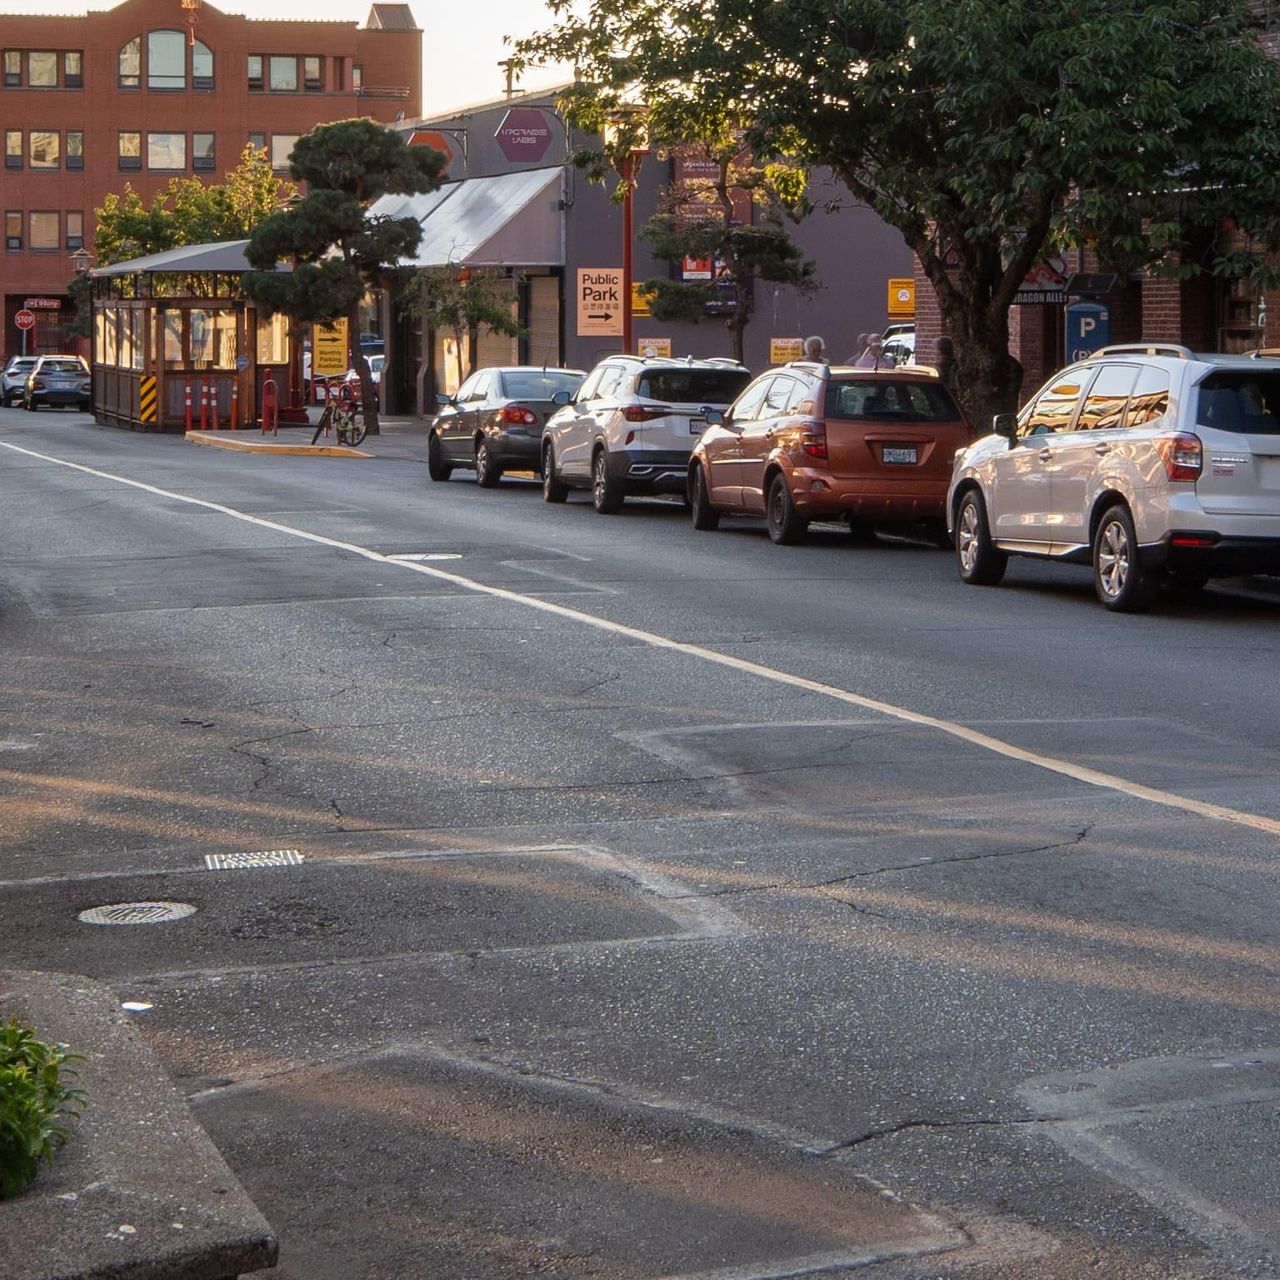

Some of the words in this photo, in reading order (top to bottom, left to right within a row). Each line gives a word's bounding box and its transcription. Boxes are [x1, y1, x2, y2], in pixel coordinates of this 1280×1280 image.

[582, 273, 620, 285] Public
[582, 286, 619, 302] Park
[17, 315, 33, 324] STOP
[1080, 317, 1096, 338] P
